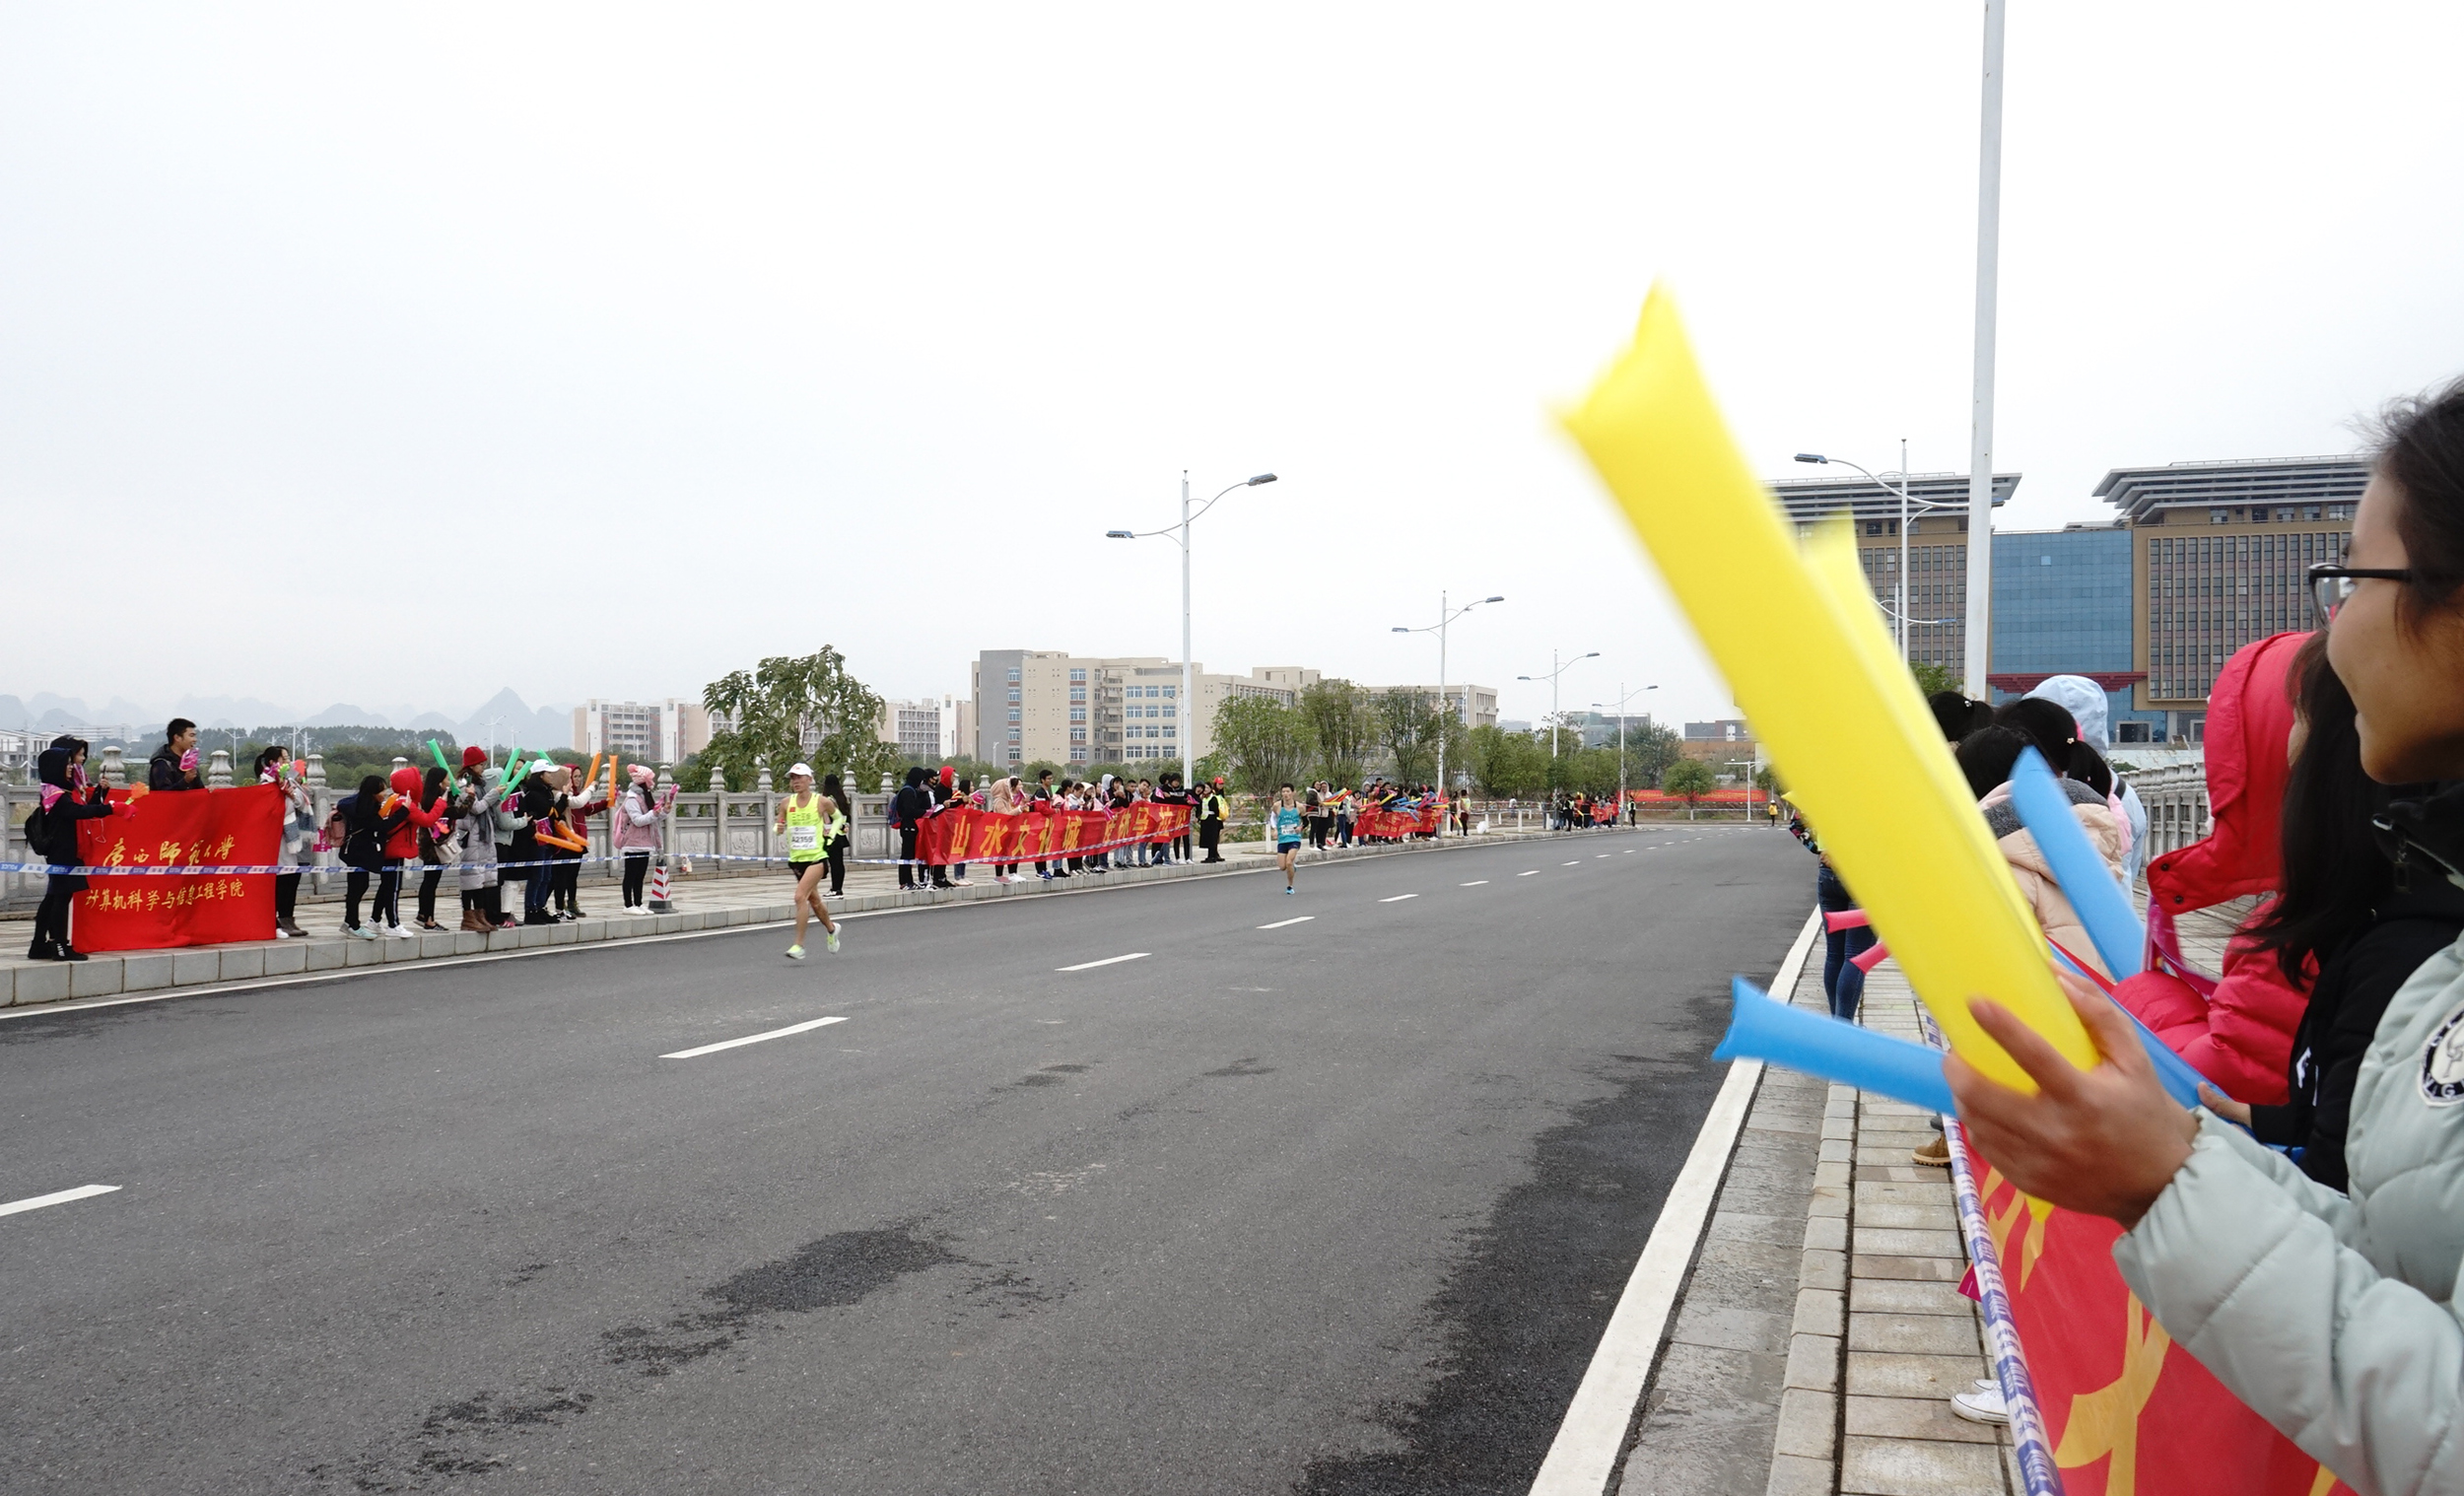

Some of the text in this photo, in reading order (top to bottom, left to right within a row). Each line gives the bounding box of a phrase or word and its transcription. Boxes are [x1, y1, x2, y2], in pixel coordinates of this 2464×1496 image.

[85, 878, 245, 913] 计算机科学与信息工程学院
